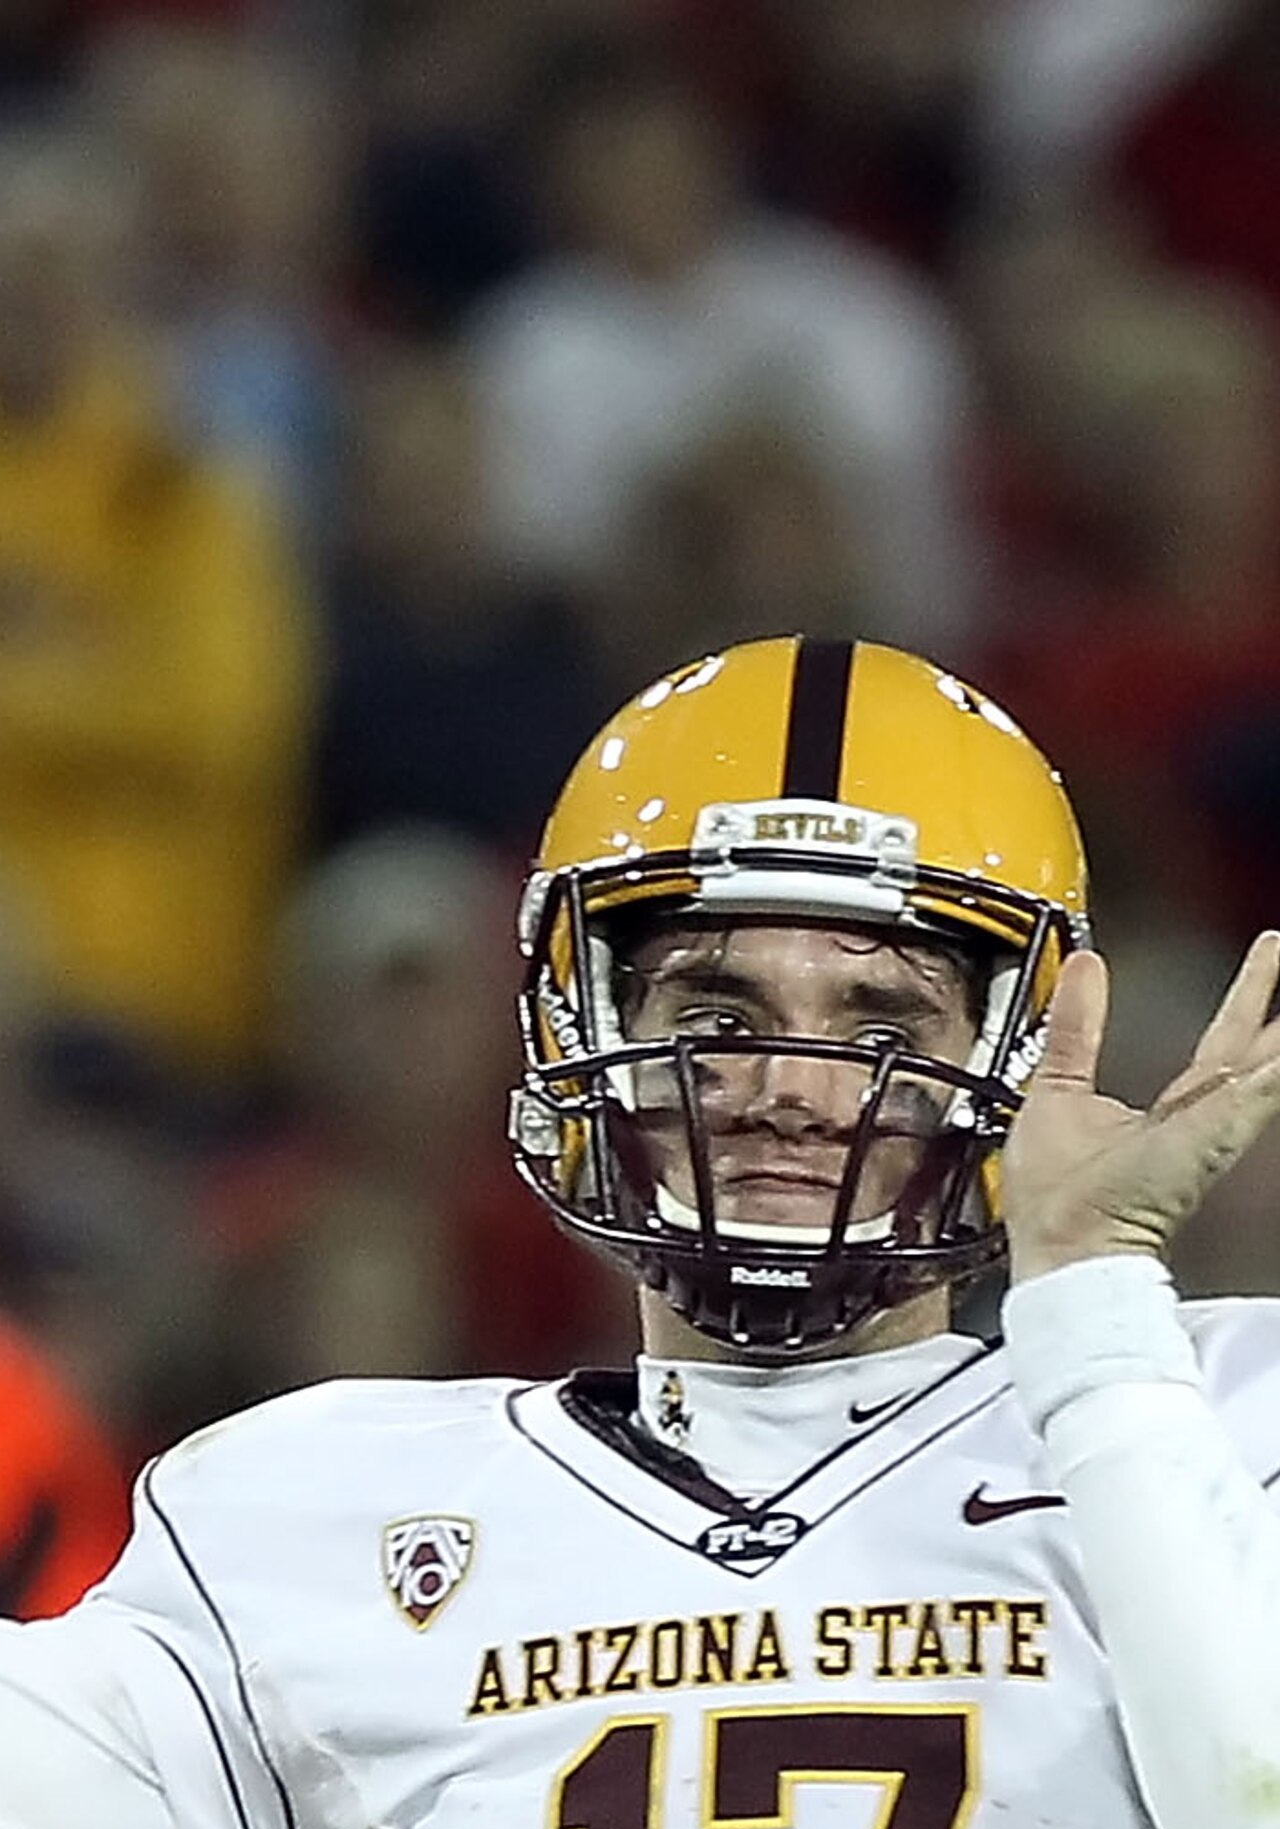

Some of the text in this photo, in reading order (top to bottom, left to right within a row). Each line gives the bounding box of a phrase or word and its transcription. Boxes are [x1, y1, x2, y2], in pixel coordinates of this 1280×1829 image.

[754, 813, 860, 845] DEVILS
[464, 1598, 1049, 1720] ARIZONA STATE
